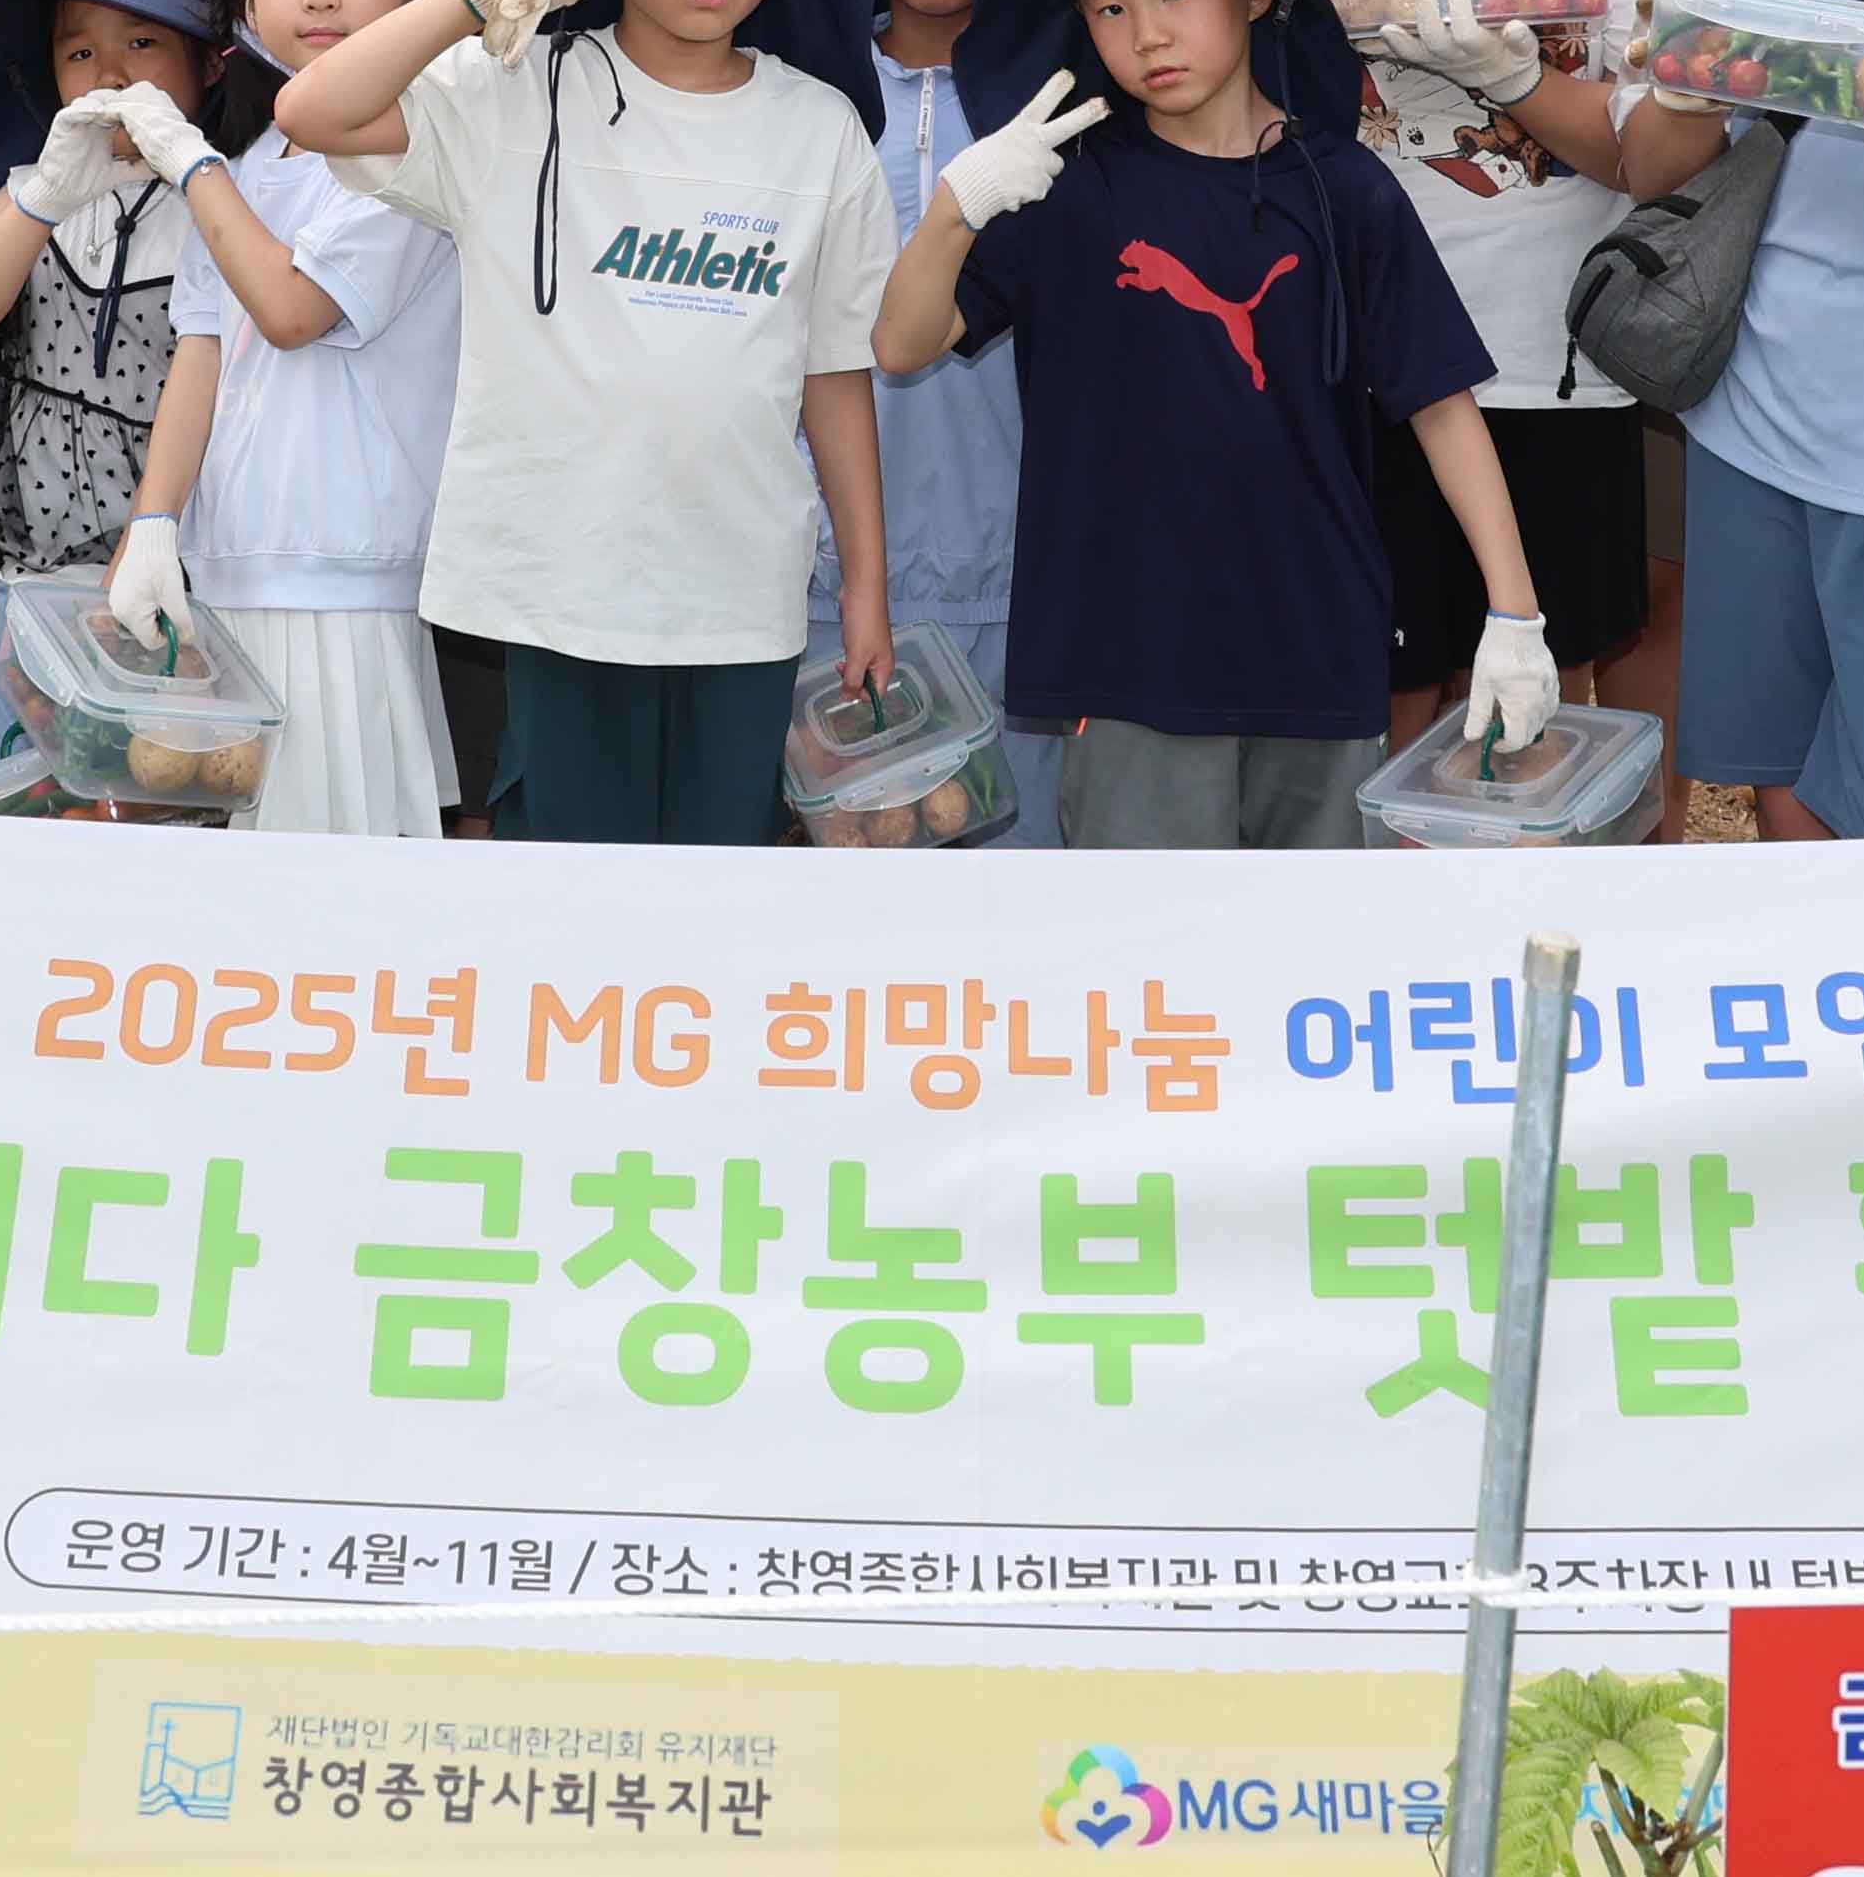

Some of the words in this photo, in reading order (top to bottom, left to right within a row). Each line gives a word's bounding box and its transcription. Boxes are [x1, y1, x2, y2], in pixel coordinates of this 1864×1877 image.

[702, 210, 750, 231] SPORTS
[752, 218, 780, 235] CLUB
[591, 225, 788, 297] Athletic
[35, 958, 477, 1097] 2025년
[526, 983, 713, 1088] MG
[758, 979, 1232, 1112] 희망나눔
[1286, 977, 1645, 1104] 어린이
[354, 1147, 1205, 1413] 금창농부
[1307, 1153, 1754, 1418] 텃밭
[68, 1521, 165, 1573] 운영
[185, 1528, 286, 1580] 기간
[329, 1535, 553, 1592] 4월~11월
[613, 1545, 708, 1596] 장소
[267, 1714, 389, 1750] 재단법인
[655, 1731, 778, 1768] 유지재단
[263, 1756, 772, 1837] 창영종합사회복지관
